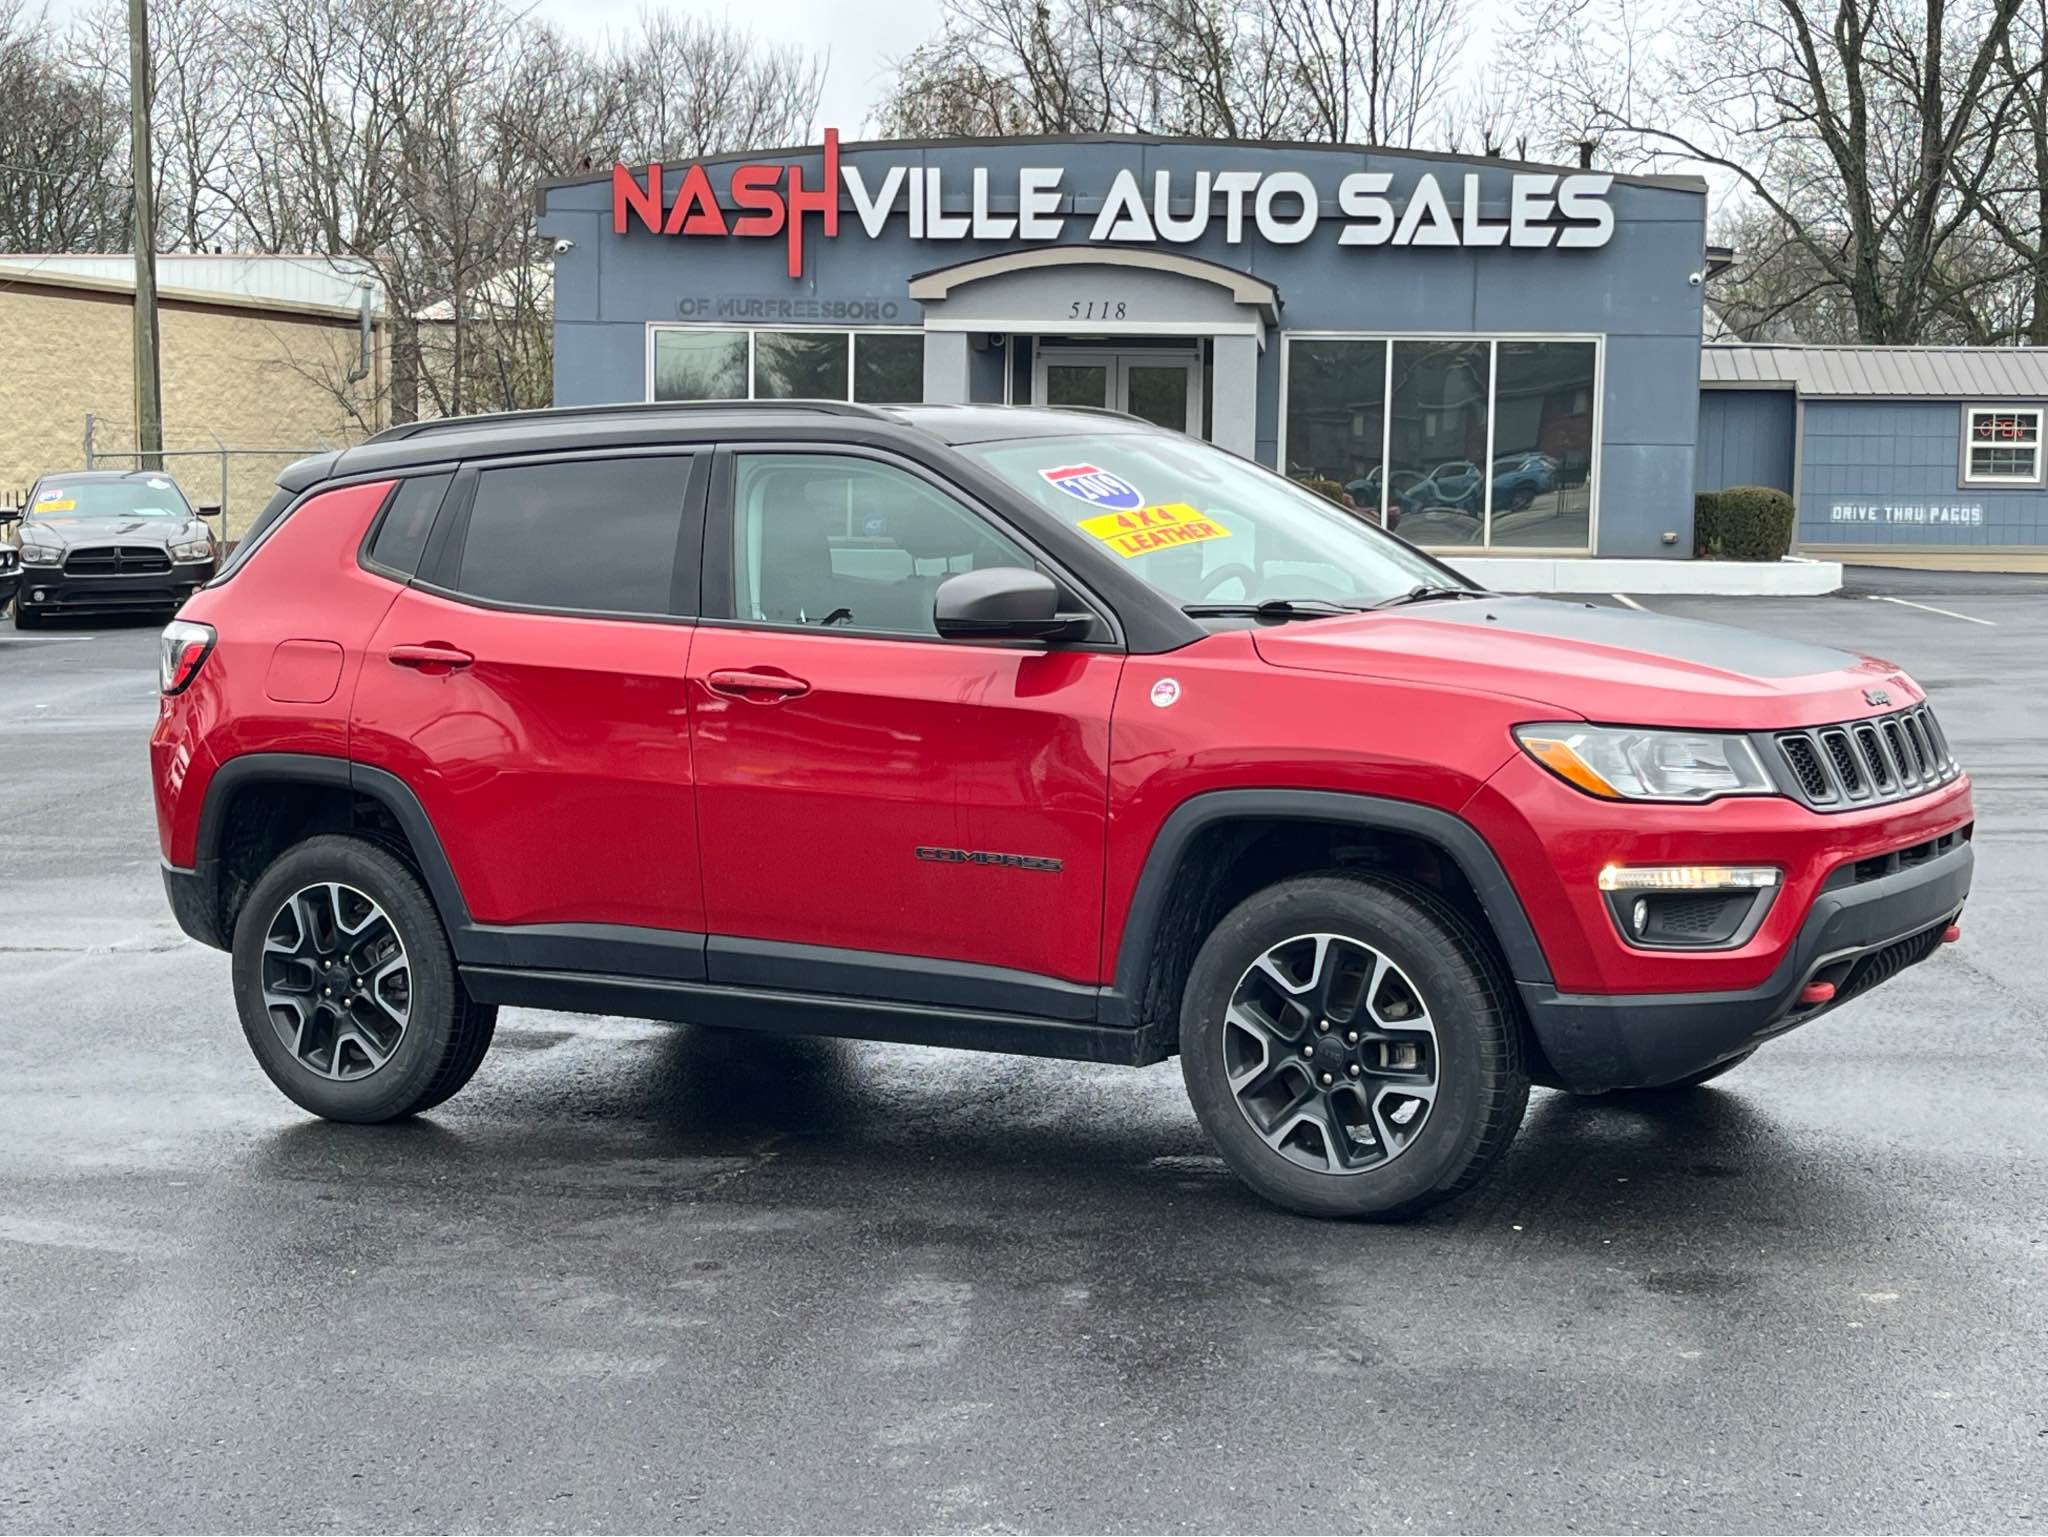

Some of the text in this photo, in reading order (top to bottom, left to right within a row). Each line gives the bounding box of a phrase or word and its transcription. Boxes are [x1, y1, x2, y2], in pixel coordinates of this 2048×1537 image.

[612, 128, 1615, 278] NASHVILLE AUTO SALES
[679, 297, 899, 320] OF MURFREESBORO
[1068, 301, 1127, 321] 5118
[1063, 472, 1131, 500] 2019
[1831, 505, 1879, 521] DRIVE
[1883, 506, 1925, 523] THRU
[1118, 522, 1219, 554] LEATHER
[914, 846, 1064, 873] COMPASS
